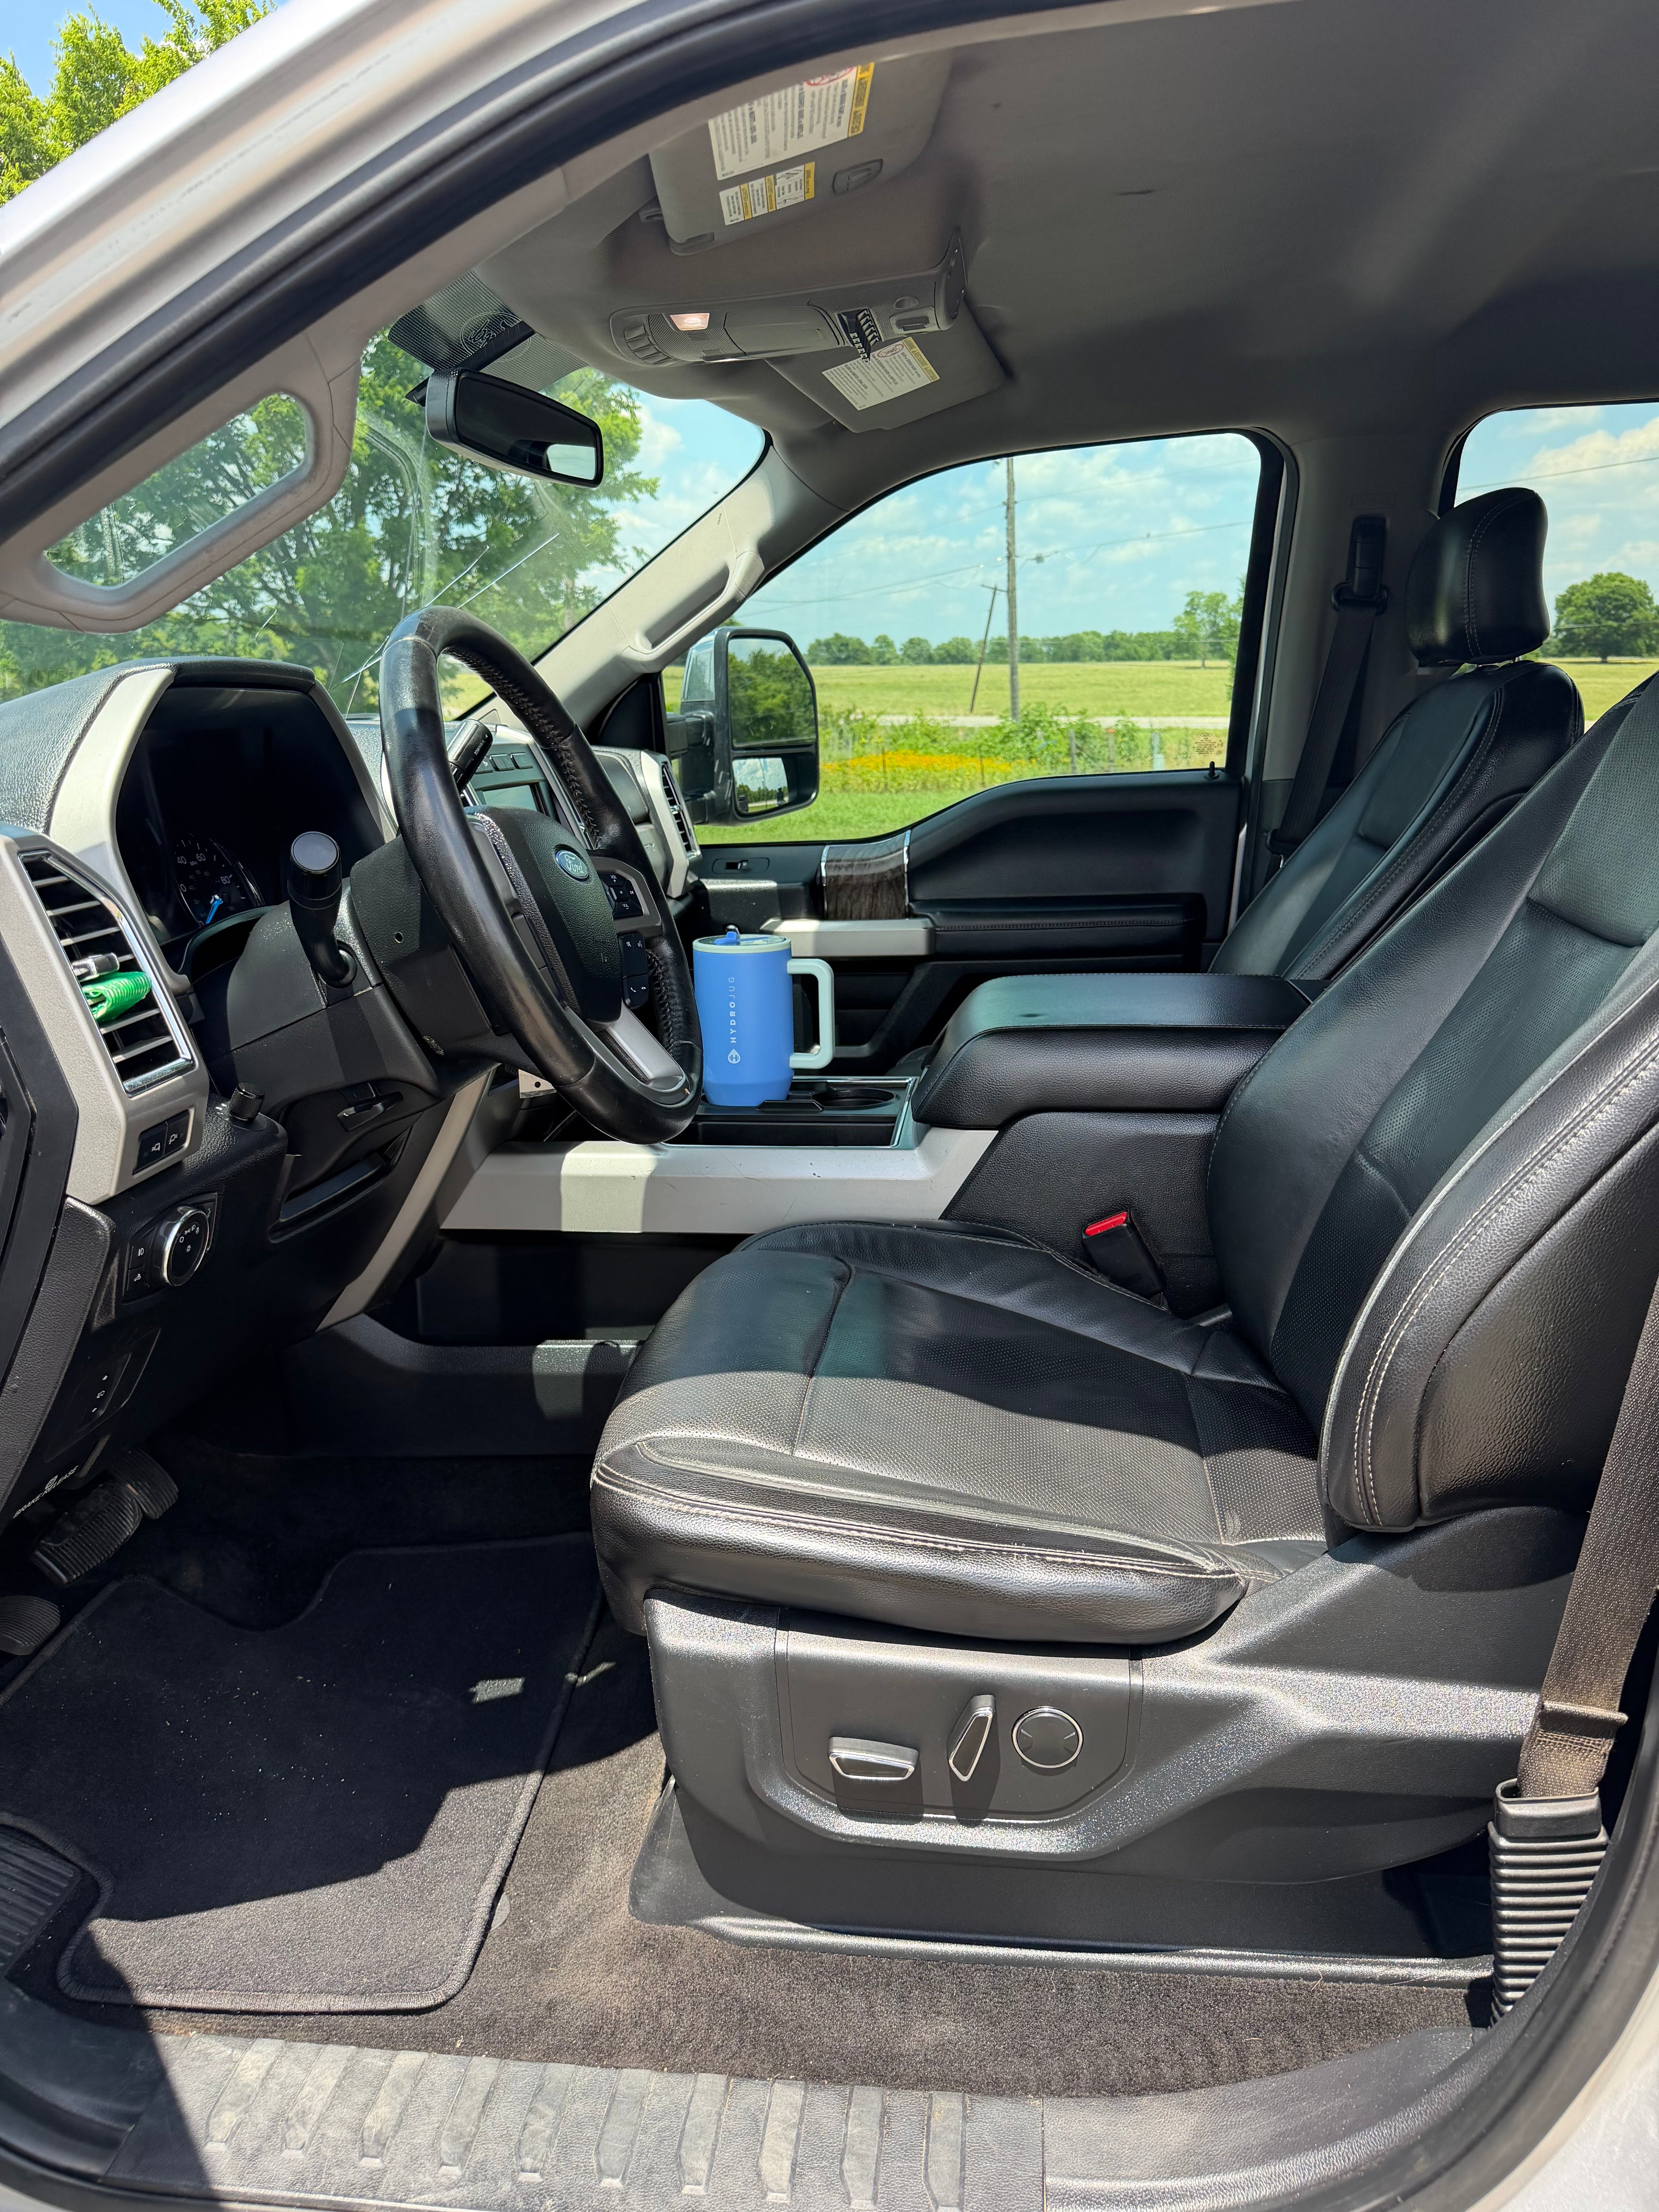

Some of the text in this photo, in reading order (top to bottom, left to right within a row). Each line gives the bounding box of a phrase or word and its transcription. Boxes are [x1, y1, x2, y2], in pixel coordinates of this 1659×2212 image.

[177, 856, 187, 864] 40
[196, 853, 206, 862] 60
[564, 854, 584, 874] Ford
[220, 876, 230, 884] 80
[728, 977, 737, 1043] HYDROJUG
[13, 1465, 79, 1519] BRAKE RELEASE
